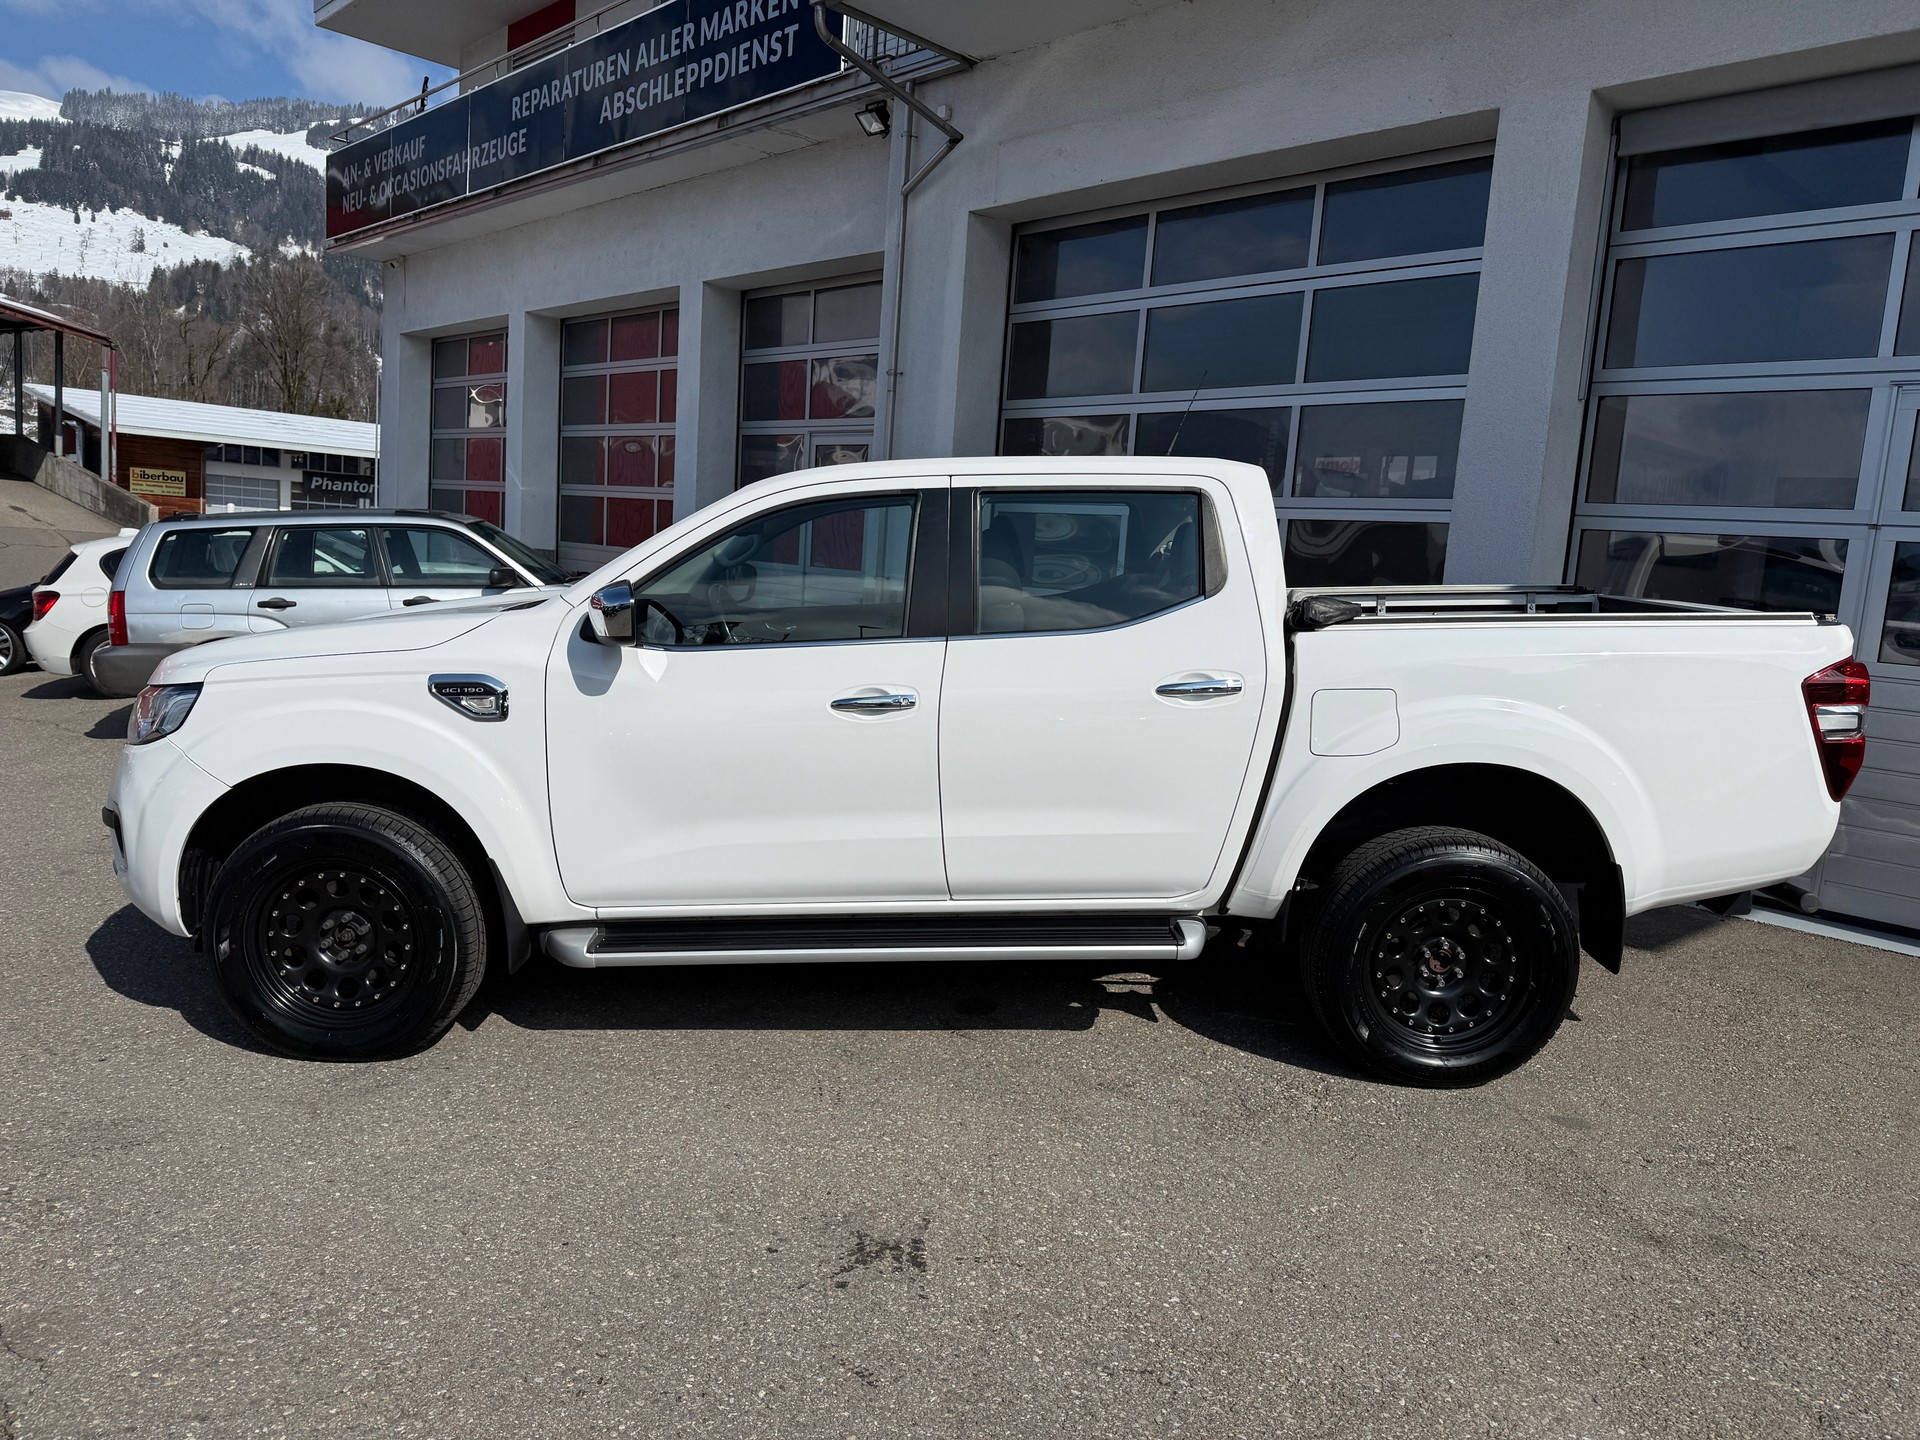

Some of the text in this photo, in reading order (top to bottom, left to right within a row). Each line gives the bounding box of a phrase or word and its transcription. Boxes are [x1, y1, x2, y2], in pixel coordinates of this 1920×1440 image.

[511, 49, 630, 121] REPARATUREN
[635, 20, 695, 72] ALLER
[600, 23, 799, 124] ABSCHLEPPDIENST
[342, 135, 426, 187] AN- & VERKAUF
[342, 128, 527, 215] NEU- & OCCASIONSFAHRZEUGE
[132, 469, 184, 482] biberbau
